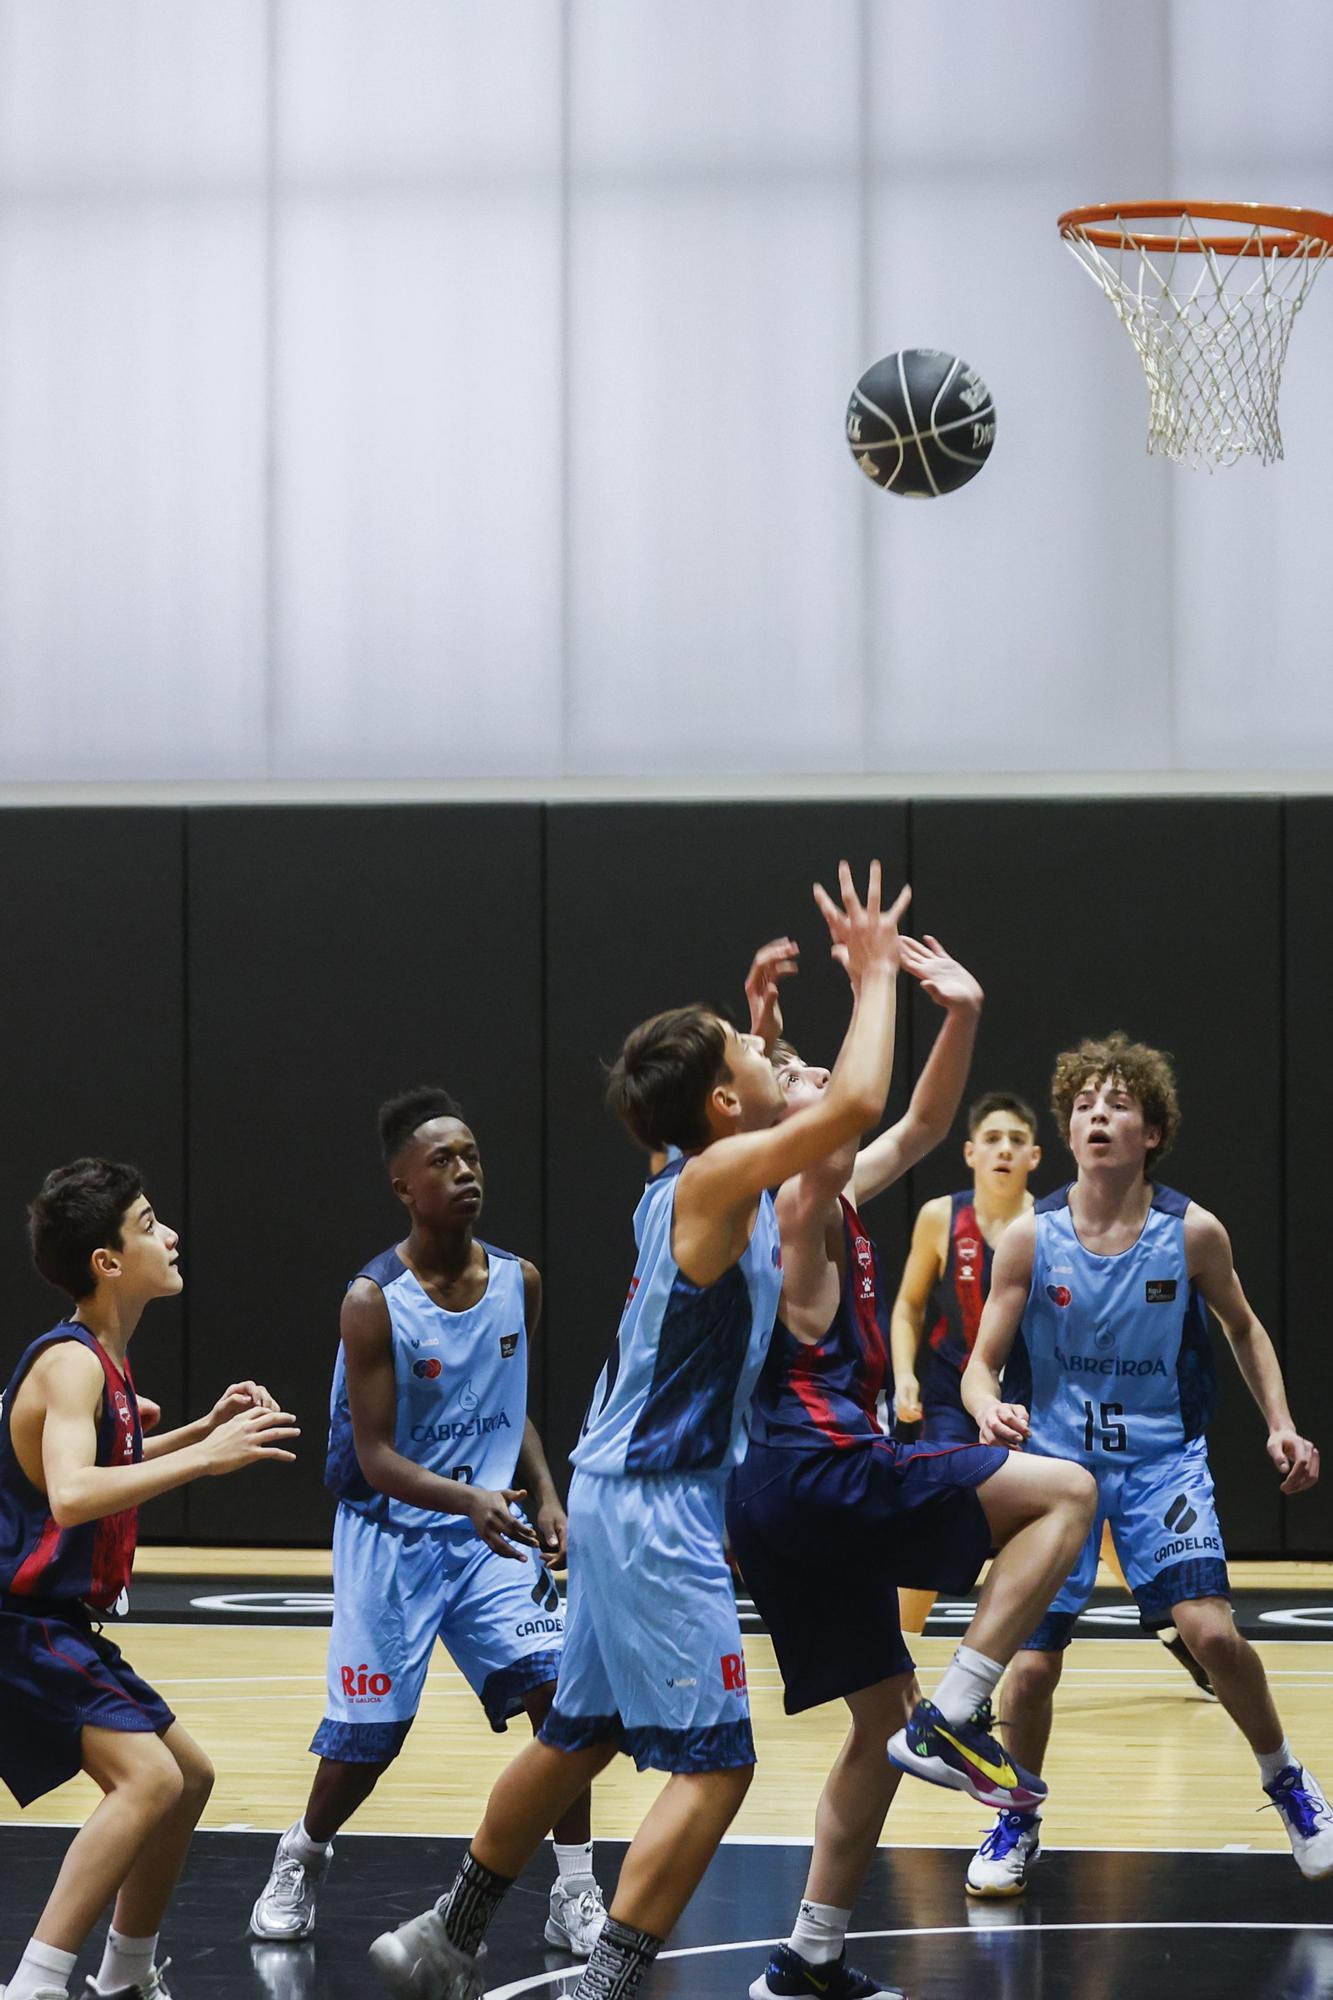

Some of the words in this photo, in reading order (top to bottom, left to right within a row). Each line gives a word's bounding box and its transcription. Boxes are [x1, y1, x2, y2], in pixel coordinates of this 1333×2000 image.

[1055, 1346, 1167, 1376] ABREIROÁ
[1083, 1400, 1127, 1452] 15
[1154, 1536, 1220, 1563] CANDELAS
[516, 1618, 563, 1637] CANDE
[341, 1663, 392, 1696] Río
